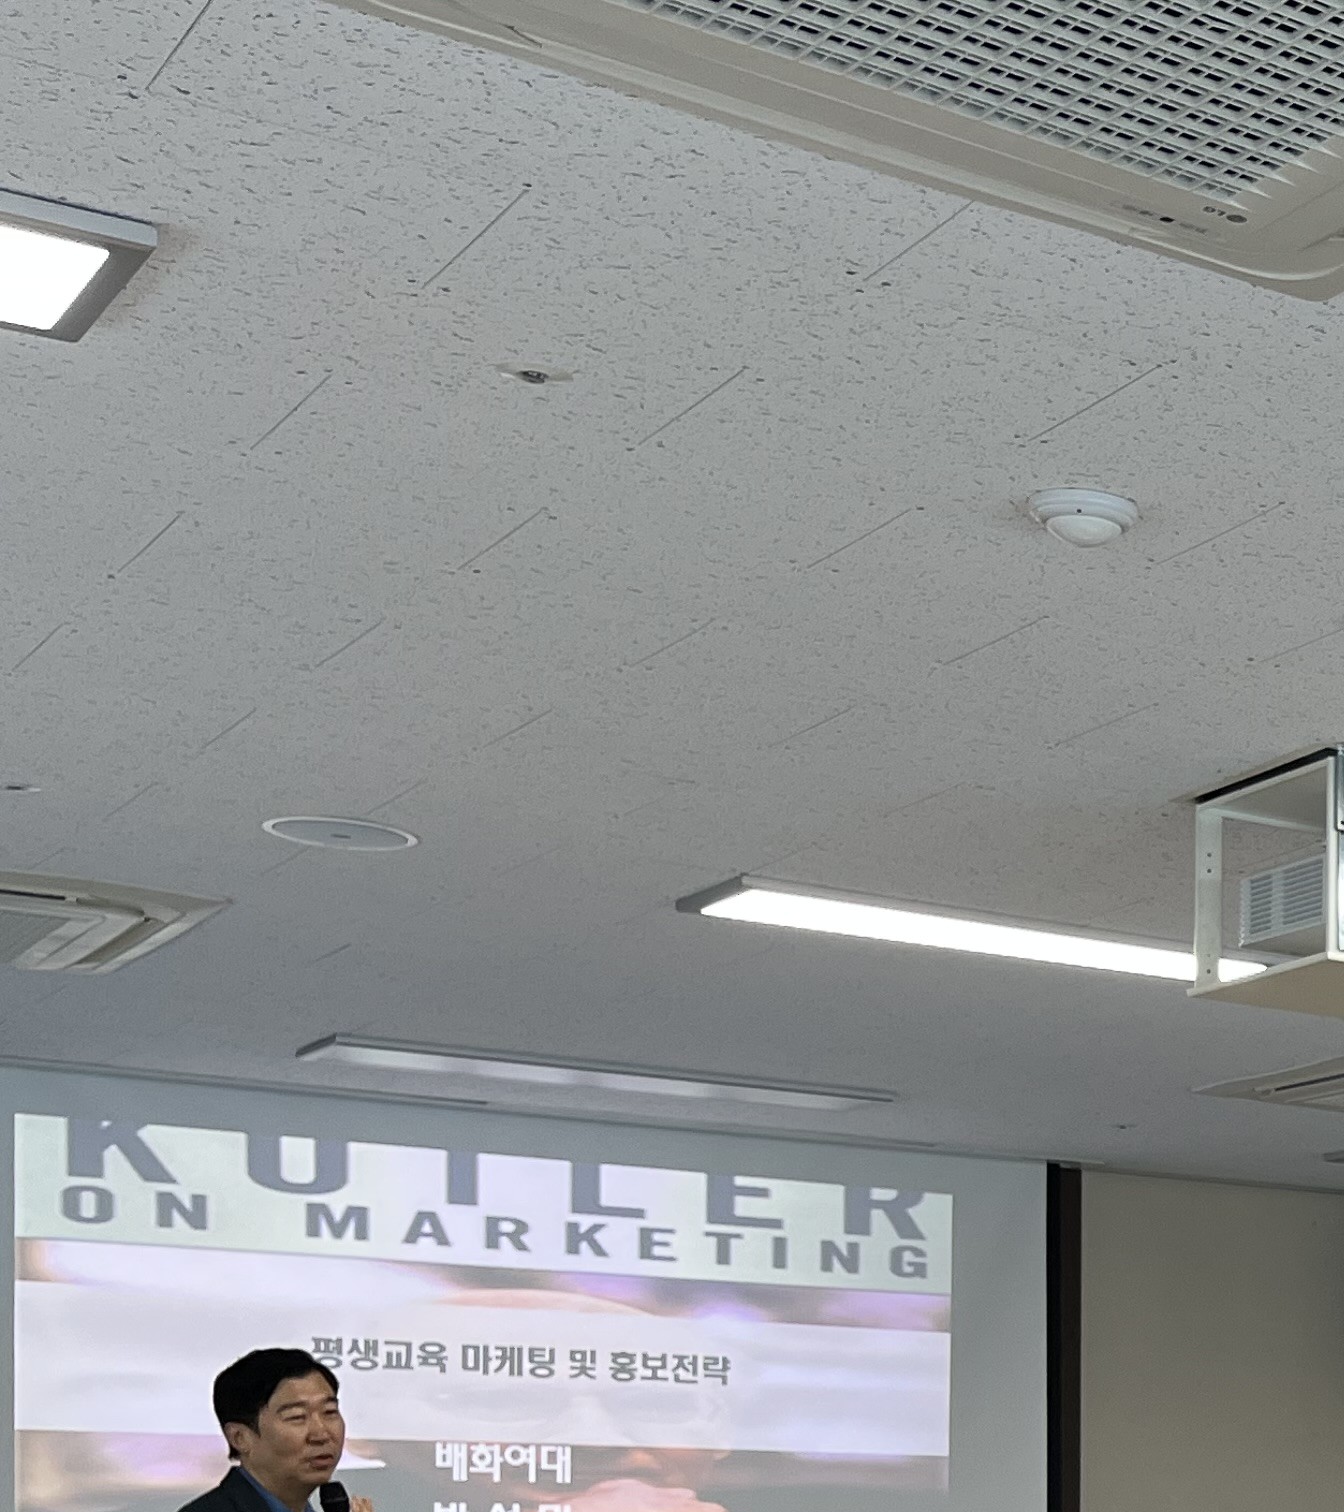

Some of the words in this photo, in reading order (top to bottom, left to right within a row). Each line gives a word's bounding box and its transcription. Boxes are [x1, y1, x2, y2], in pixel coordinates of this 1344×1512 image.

[60, 1185, 208, 1230] ON
[305, 1203, 928, 1279] MARKETING
[311, 1336, 448, 1374] 평생교육
[461, 1343, 557, 1378] 마케팅
[568, 1349, 597, 1380] 및
[609, 1350, 731, 1386] 홍보전략
[434, 1440, 573, 1484] 배화여대
